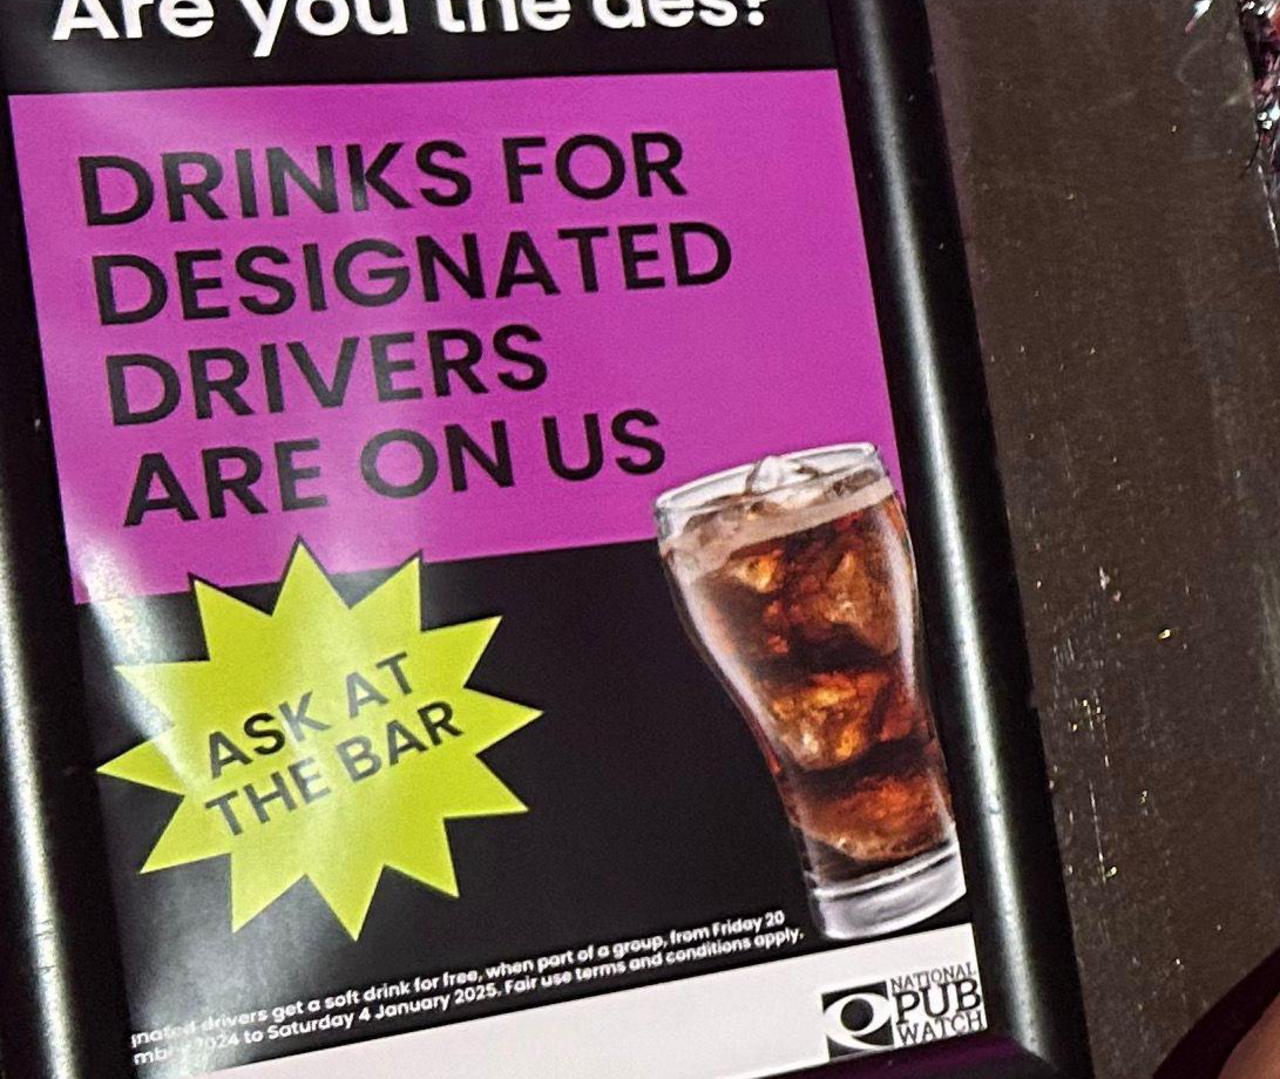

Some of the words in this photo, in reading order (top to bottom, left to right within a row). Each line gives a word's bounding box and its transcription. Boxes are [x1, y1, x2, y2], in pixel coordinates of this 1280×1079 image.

[77, 139, 473, 227] DRINKS
[502, 131, 687, 205] FOR
[92, 221, 734, 326] DESIGNATED
[105, 324, 549, 427] DRIVERS
[123, 438, 329, 527] ARE
[360, 420, 516, 500] ON
[545, 409, 667, 481] US
[207, 691, 331, 780] ASK
[345, 651, 413, 719] AT
[205, 756, 331, 837] THE
[336, 700, 465, 783] BAR
[200, 1007, 268, 1033] drivers
[271, 1000, 304, 1024] get
[307, 998, 322, 1013] a
[325, 990, 361, 1009] soft
[363, 980, 411, 1003] drink
[414, 976, 440, 993] for
[443, 968, 483, 987] free,
[485, 959, 535, 980] when
[537, 950, 575, 974] part
[577, 944, 595, 962] of
[597, 944, 610, 959] a
[612, 933, 668, 960] group,
[669, 927, 711, 946] from
[712, 915, 764, 936] Friday
[765, 910, 786, 928] 20
[244, 1029, 264, 1045] to
[267, 1012, 354, 1041] Saturday
[358, 1007, 372, 1022] 4
[374, 993, 451, 1020] January
[454, 983, 502, 1006] 2025.
[505, 975, 538, 995] Fair
[541, 970, 573, 988] use
[576, 960, 627, 982] terms
[629, 951, 664, 972] and
[665, 936, 752, 964] conditions
[754, 926, 805, 950] apply.
[890, 961, 977, 994] NATIONAL
[892, 977, 983, 1026] PUB
[897, 1009, 986, 1048] WATCH
